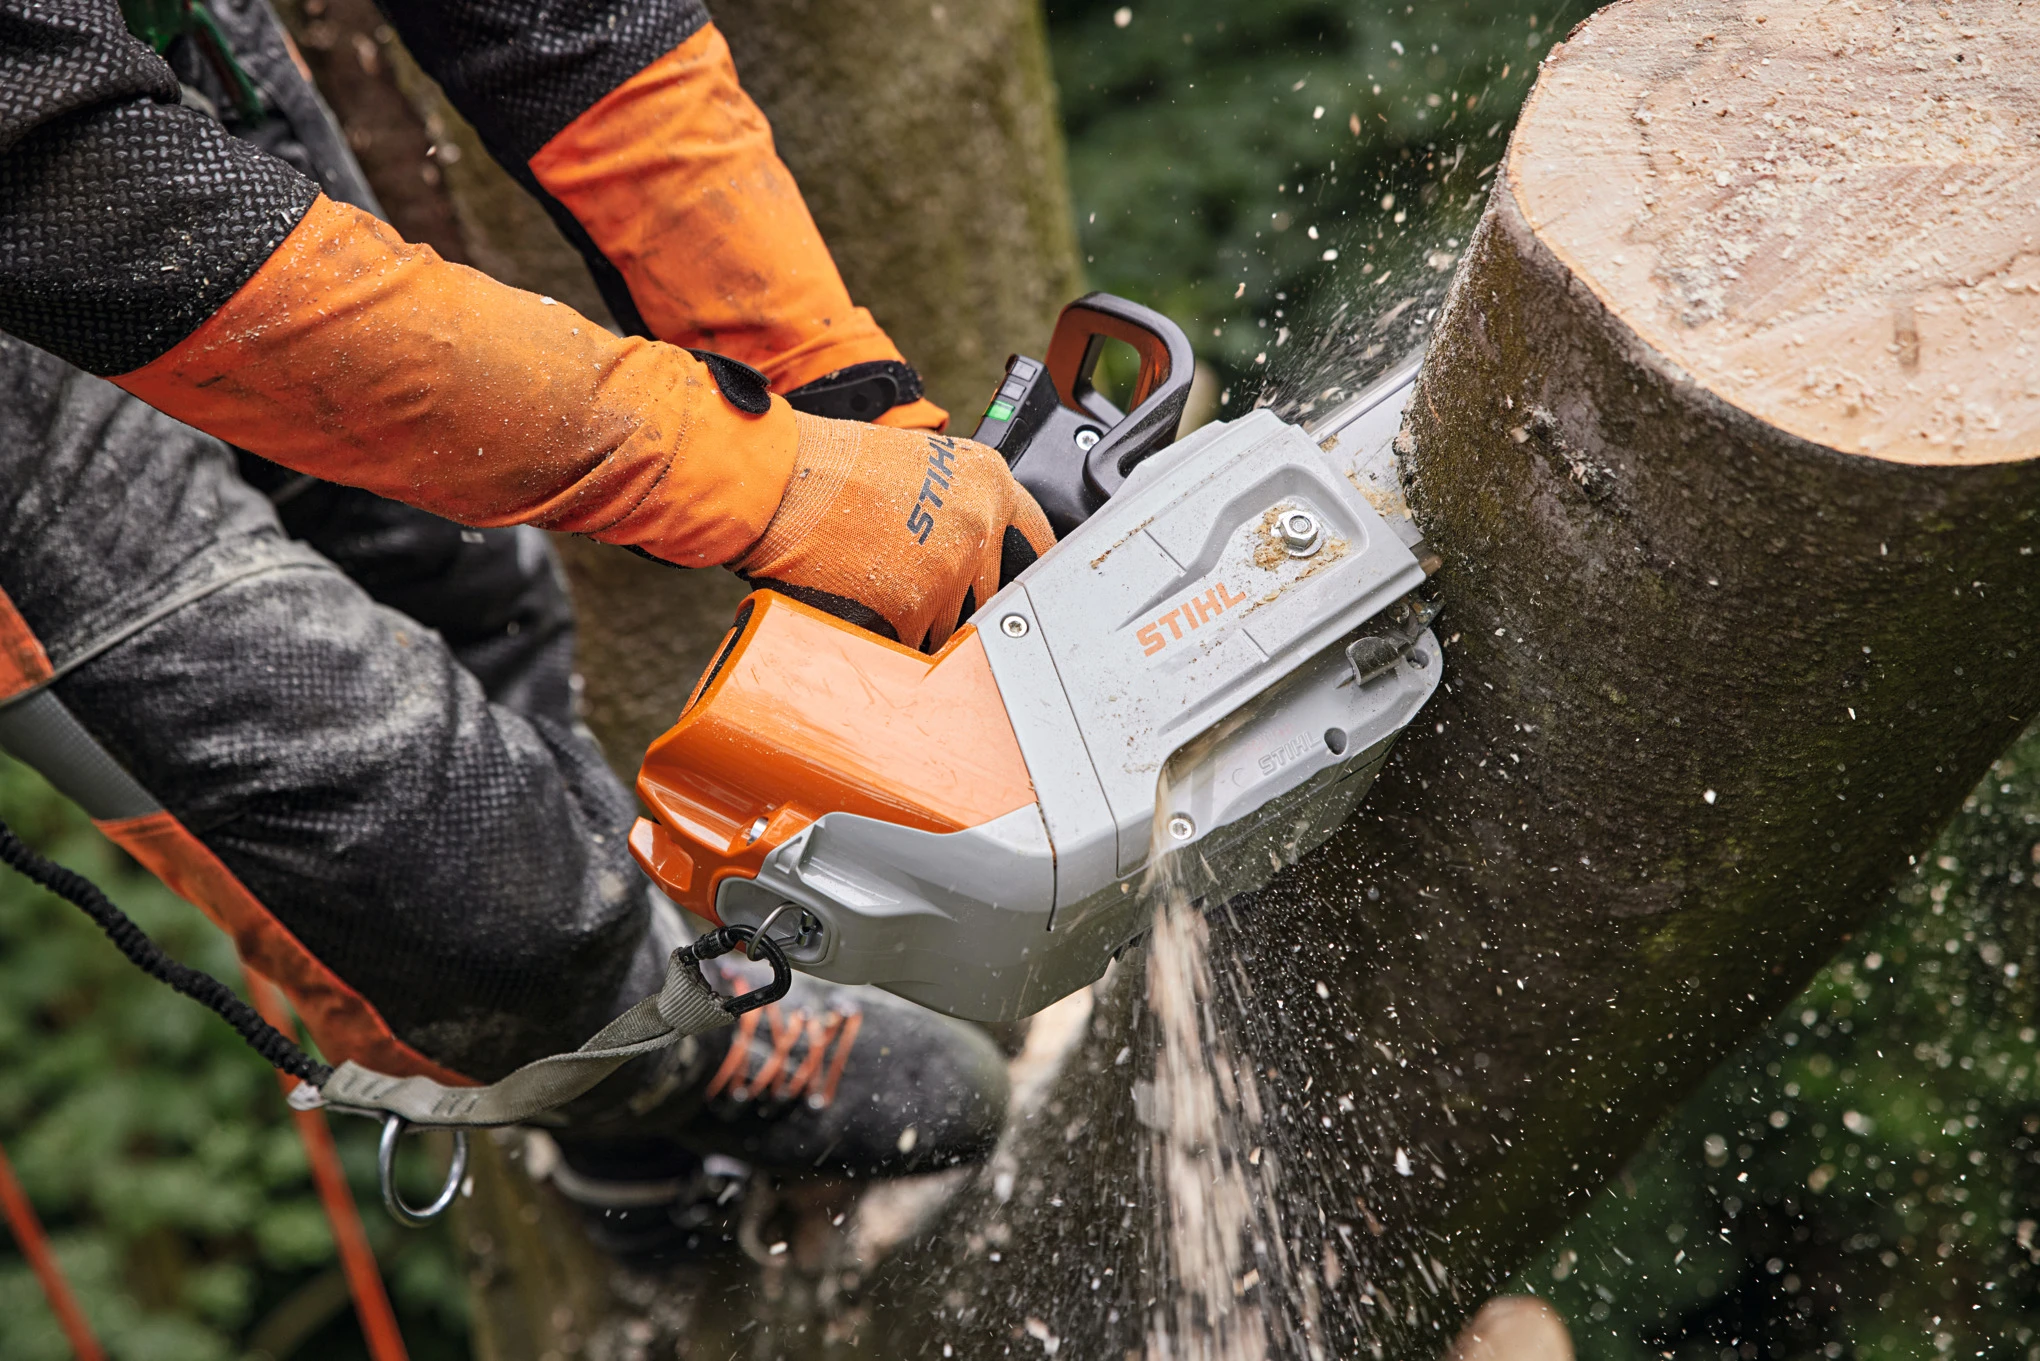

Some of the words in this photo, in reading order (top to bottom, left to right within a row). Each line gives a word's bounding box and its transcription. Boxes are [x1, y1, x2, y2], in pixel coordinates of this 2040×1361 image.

[907, 436, 955, 545] STIHL
[1136, 582, 1247, 657] STIHL
[1257, 732, 1322, 776] STIHL
